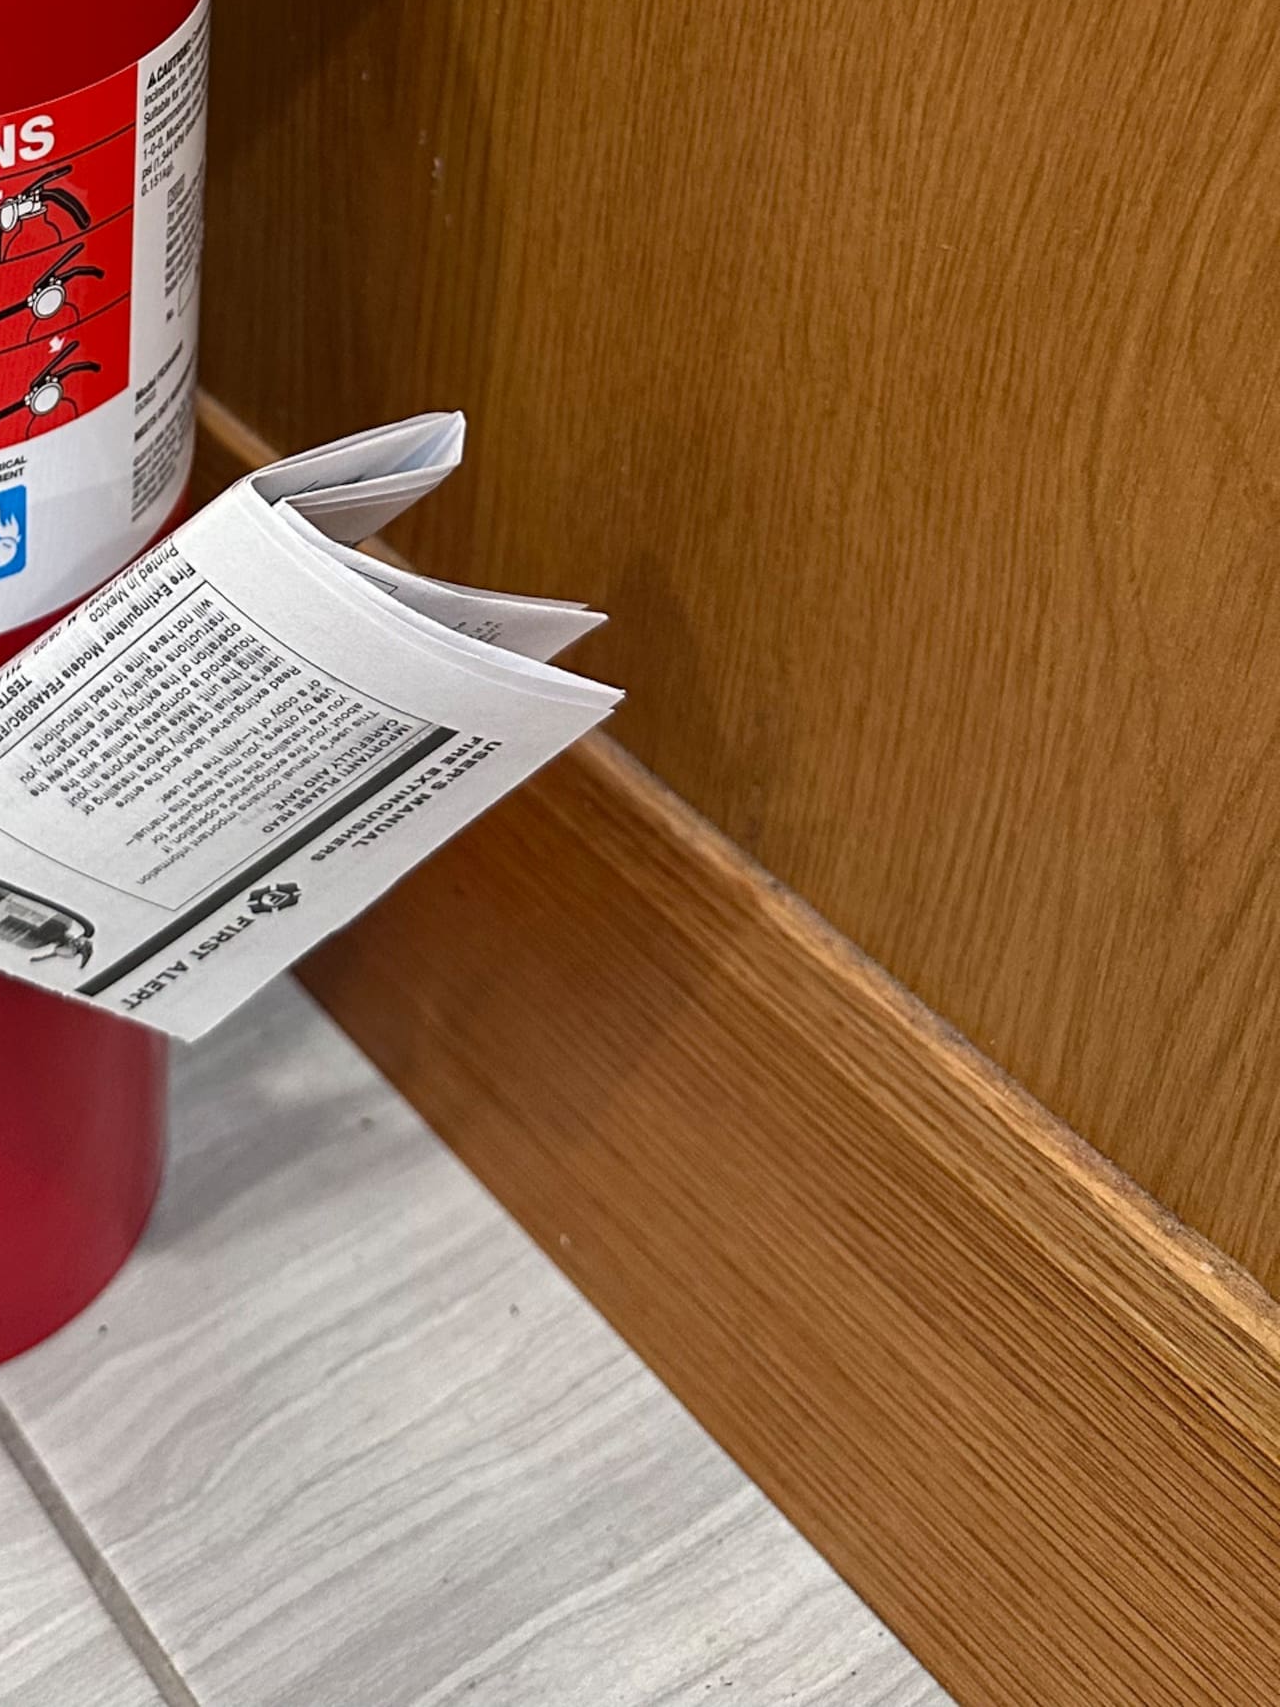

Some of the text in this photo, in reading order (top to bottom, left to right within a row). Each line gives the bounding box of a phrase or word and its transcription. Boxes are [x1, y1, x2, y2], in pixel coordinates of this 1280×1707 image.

[138, 543, 180, 583] Printed
[167, 562, 197, 586] Fire
[126, 577, 142, 591] in
[88, 587, 130, 623] Mexico
[100, 582, 174, 646] Extinguisher
[191, 598, 214, 619] will
[172, 613, 195, 634] not
[147, 629, 179, 654] have
[164, 609, 230, 663] instructions
[189, 622, 242, 666] operation
[61, 641, 106, 679] Models
[124, 651, 153, 674] time
[177, 663, 193, 679] of
[112, 670, 129, 684] to
[159, 673, 182, 690] the
[307, 679, 321, 692] or
[88, 680, 116, 706] read
[107, 698, 125, 711] In
[311, 687, 336, 704] use
[59, 633, 260, 793] household is completely familiar with the
[92, 708, 110, 723] an
[269, 695, 299, 719] copy
[297, 702, 318, 716] by
[329, 702, 363, 728] about
[66, 644, 272, 808] using the unit. Make sure everyone in your
[257, 716, 273, 730] of
[81, 655, 286, 816] user's manual carefully before installing or
[115, 665, 302, 809] Read extinguisher label and the entire
[306, 724, 332, 746] your
[330, 718, 399, 770] CAREFULLY
[77, 738, 100, 760] and
[240, 741, 264, 759] you
[287, 744, 309, 759] fire
[45, 755, 81, 784] review
[151, 693, 351, 845] you are installing this fire extinguisher for
[201, 755, 224, 770] the
[213, 757, 243, 780] must
[19, 764, 42, 785] you
[181, 768, 204, 788] end
[303, 767, 330, 789] AND
[29, 781, 50, 797] the
[137, 710, 380, 885] This user's manual contains important information
[187, 777, 219, 799] leave
[293, 776, 342, 811] PLEASE
[310, 735, 484, 862] FIRE EXTINGUISHERS
[351, 741, 503, 848] USER'S MANUAL
[168, 797, 191, 813] this
[261, 809, 297, 834] READ
[121, 915, 256, 1011] FIRST ALERT
